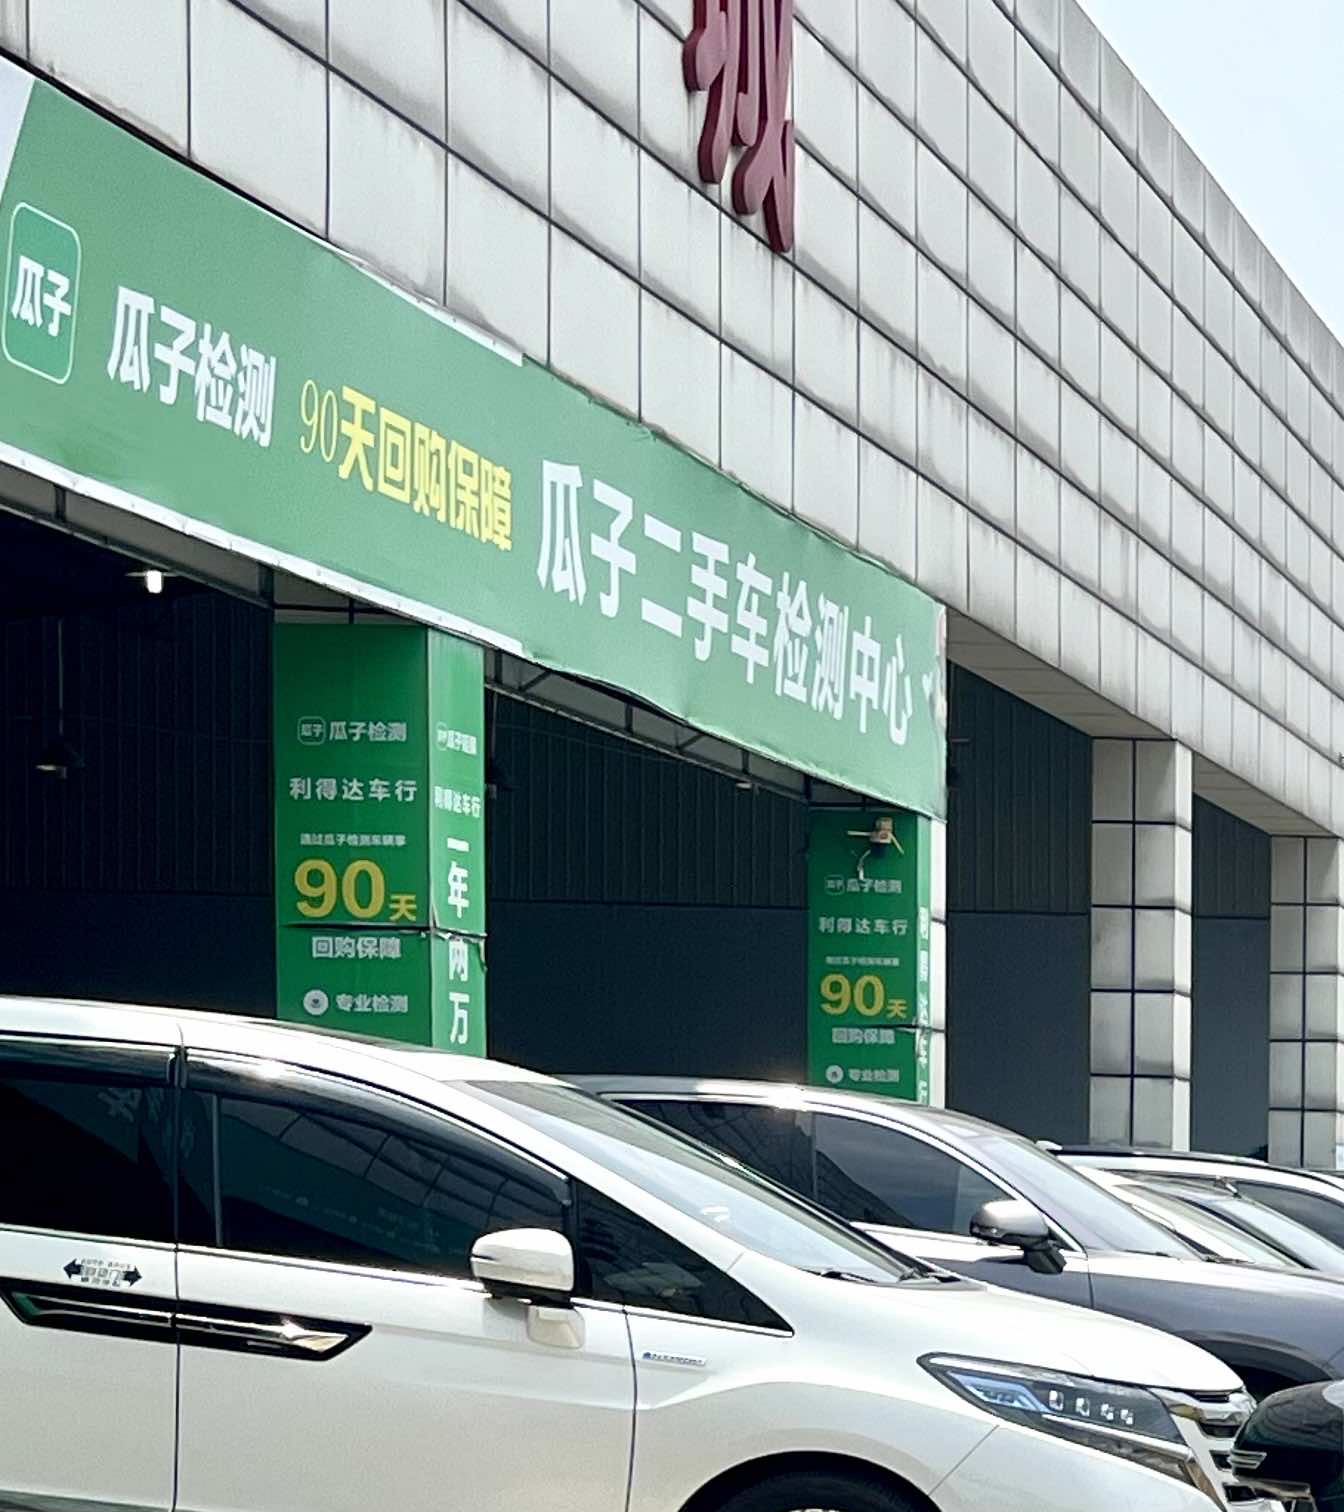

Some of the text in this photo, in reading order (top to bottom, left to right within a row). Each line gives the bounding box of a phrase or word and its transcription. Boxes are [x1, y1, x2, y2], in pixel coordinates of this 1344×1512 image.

[11, 256, 73, 339] 瓜子
[107, 285, 913, 747] 瓜子检测 90天回购保障 瓜子二手车检测中心
[329, 720, 407, 743] 瓜子检测
[289, 777, 417, 802] 利得达车行
[818, 916, 909, 936] 利得达车行
[312, 936, 402, 960] 回购保障
[335, 993, 409, 1013] 专业检测
